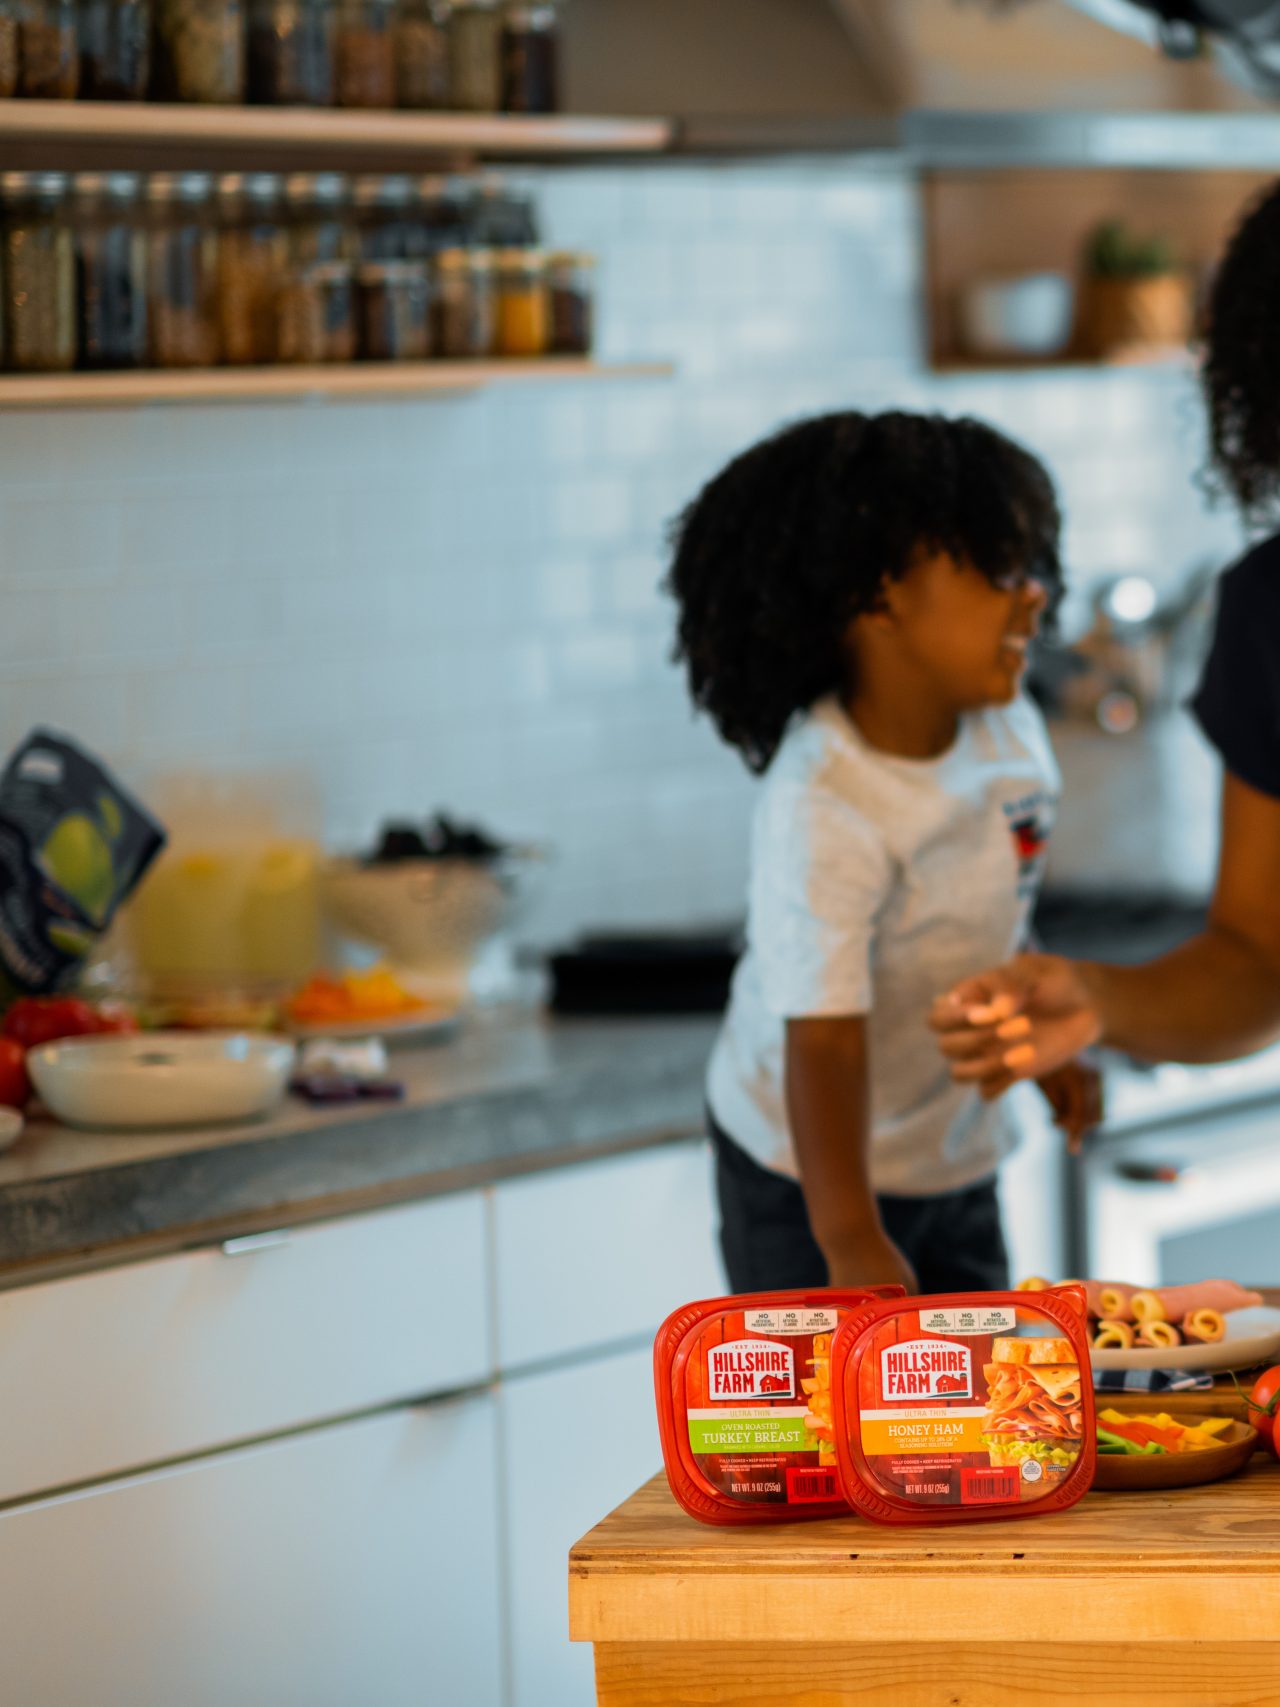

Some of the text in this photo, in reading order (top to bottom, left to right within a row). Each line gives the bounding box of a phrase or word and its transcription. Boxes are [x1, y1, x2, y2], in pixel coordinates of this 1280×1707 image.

[713, 1351, 790, 1372] HILLSHIRE
[887, 1351, 967, 1373] HILLSHIRE
[714, 1373, 755, 1393] FARM
[888, 1373, 931, 1394] FARM
[702, 1431, 801, 1444] TURKEY BREAST
[888, 1423, 964, 1437] HONEY HAM
[731, 1483, 741, 1492] NET
[742, 1483, 752, 1492] WT.
[756, 1483, 764, 1491] OZ
[905, 1485, 915, 1494] NET
[927, 1484, 935, 1493] OZ
